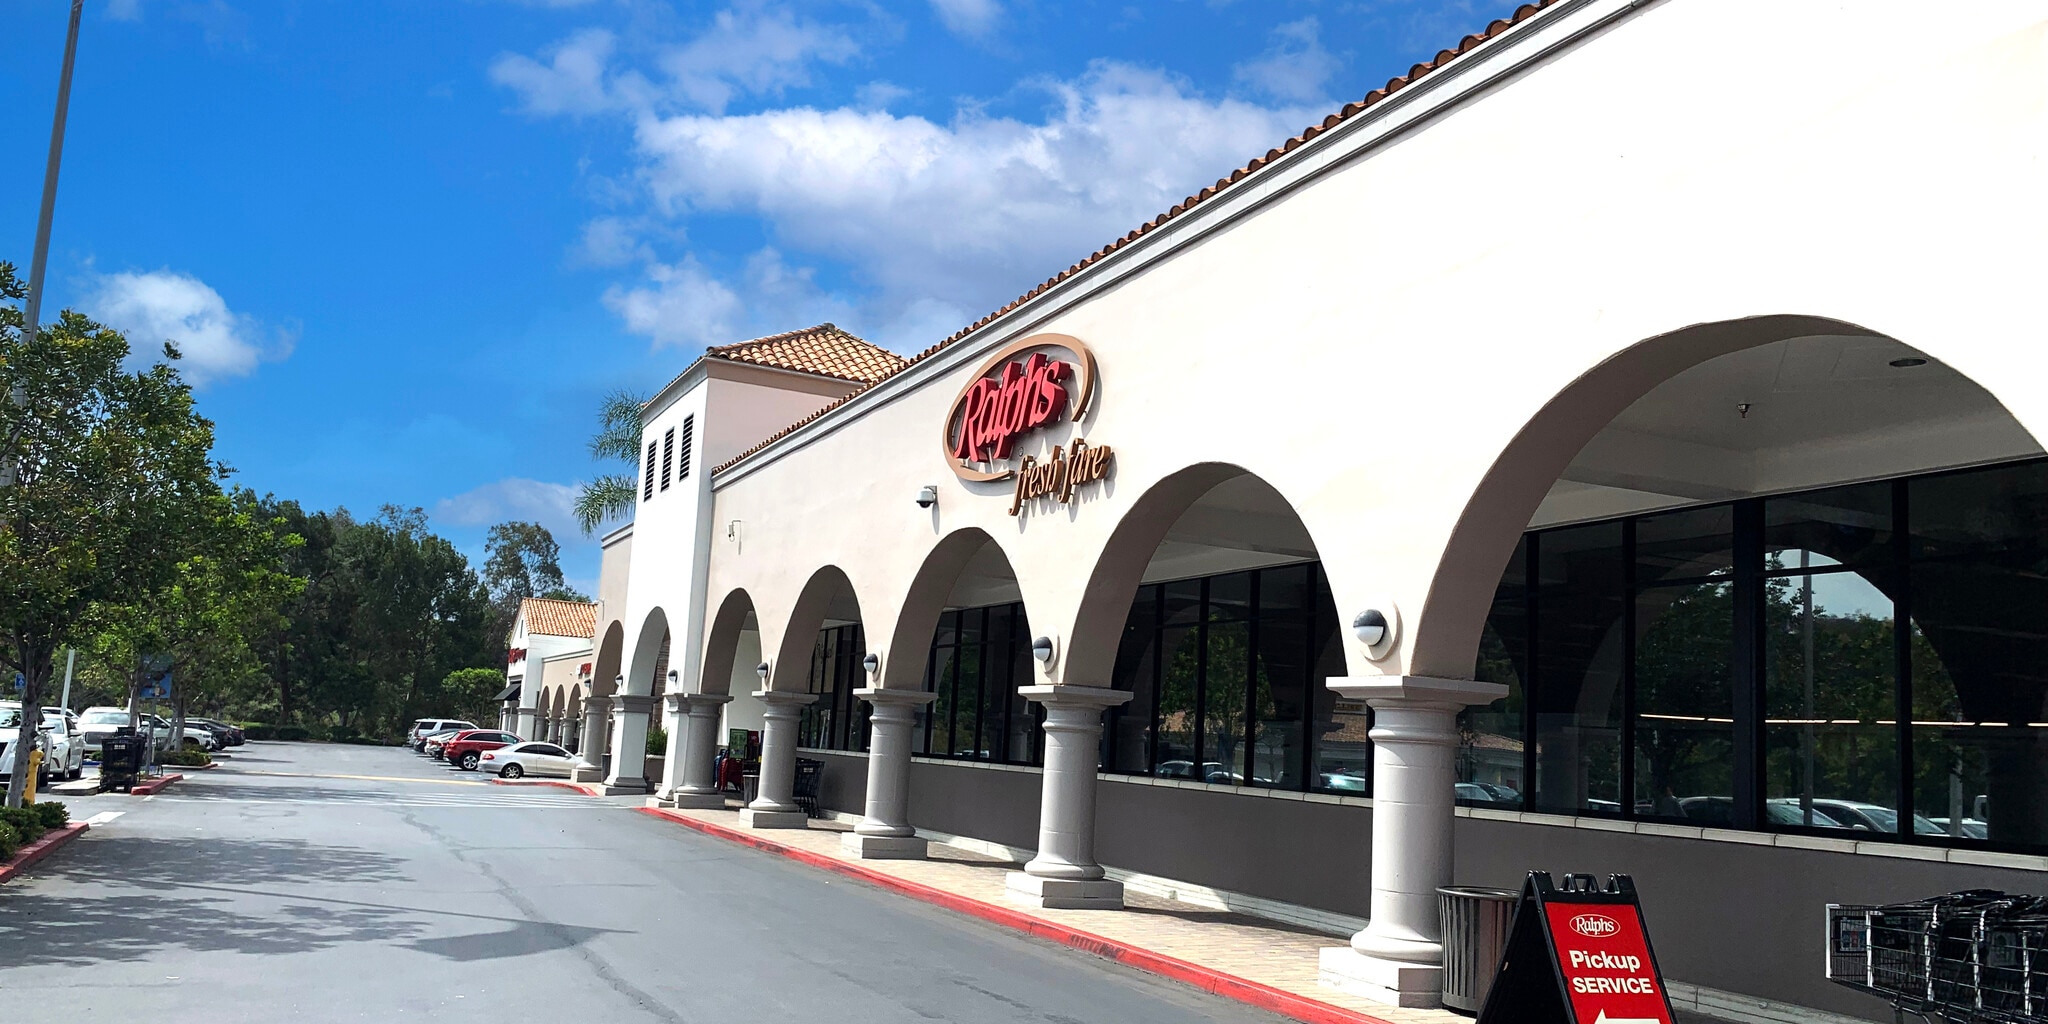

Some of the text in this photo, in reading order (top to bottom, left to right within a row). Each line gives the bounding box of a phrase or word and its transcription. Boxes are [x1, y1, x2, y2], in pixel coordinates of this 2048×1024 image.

[953, 353, 1071, 462] Ralphs
[1008, 438, 1111, 516] fresh fare
[1574, 916, 1615, 935] Ralphs
[1568, 950, 1641, 973] Pickup
[1572, 977, 1654, 994] SERVICE
